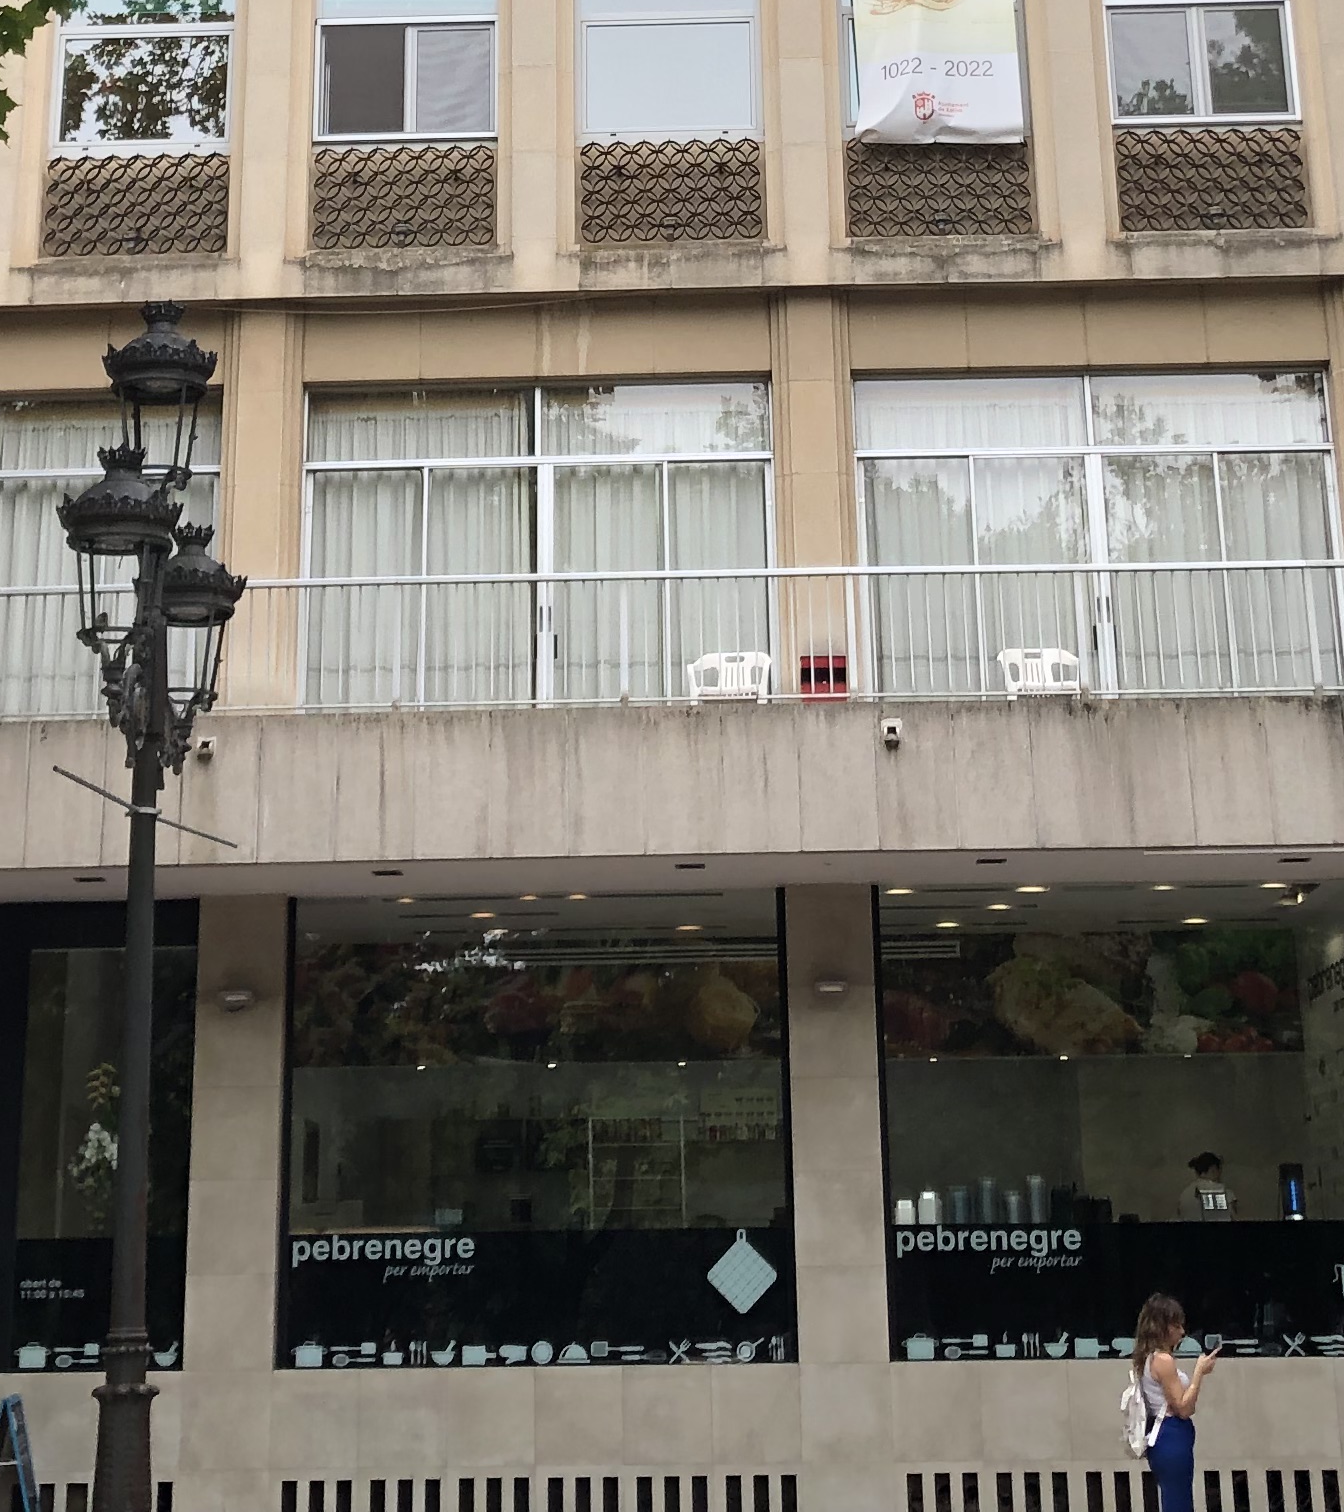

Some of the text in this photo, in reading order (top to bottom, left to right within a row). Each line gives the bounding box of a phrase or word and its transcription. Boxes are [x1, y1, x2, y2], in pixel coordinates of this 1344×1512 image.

[881, 57, 923, 80] 1022
[944, 60, 994, 77] 2022
[292, 1235, 476, 1268] pebrenegre
[896, 1224, 1082, 1258] pebrenegre
[382, 1263, 475, 1284] per emportar
[990, 1254, 1082, 1275] per emportar
